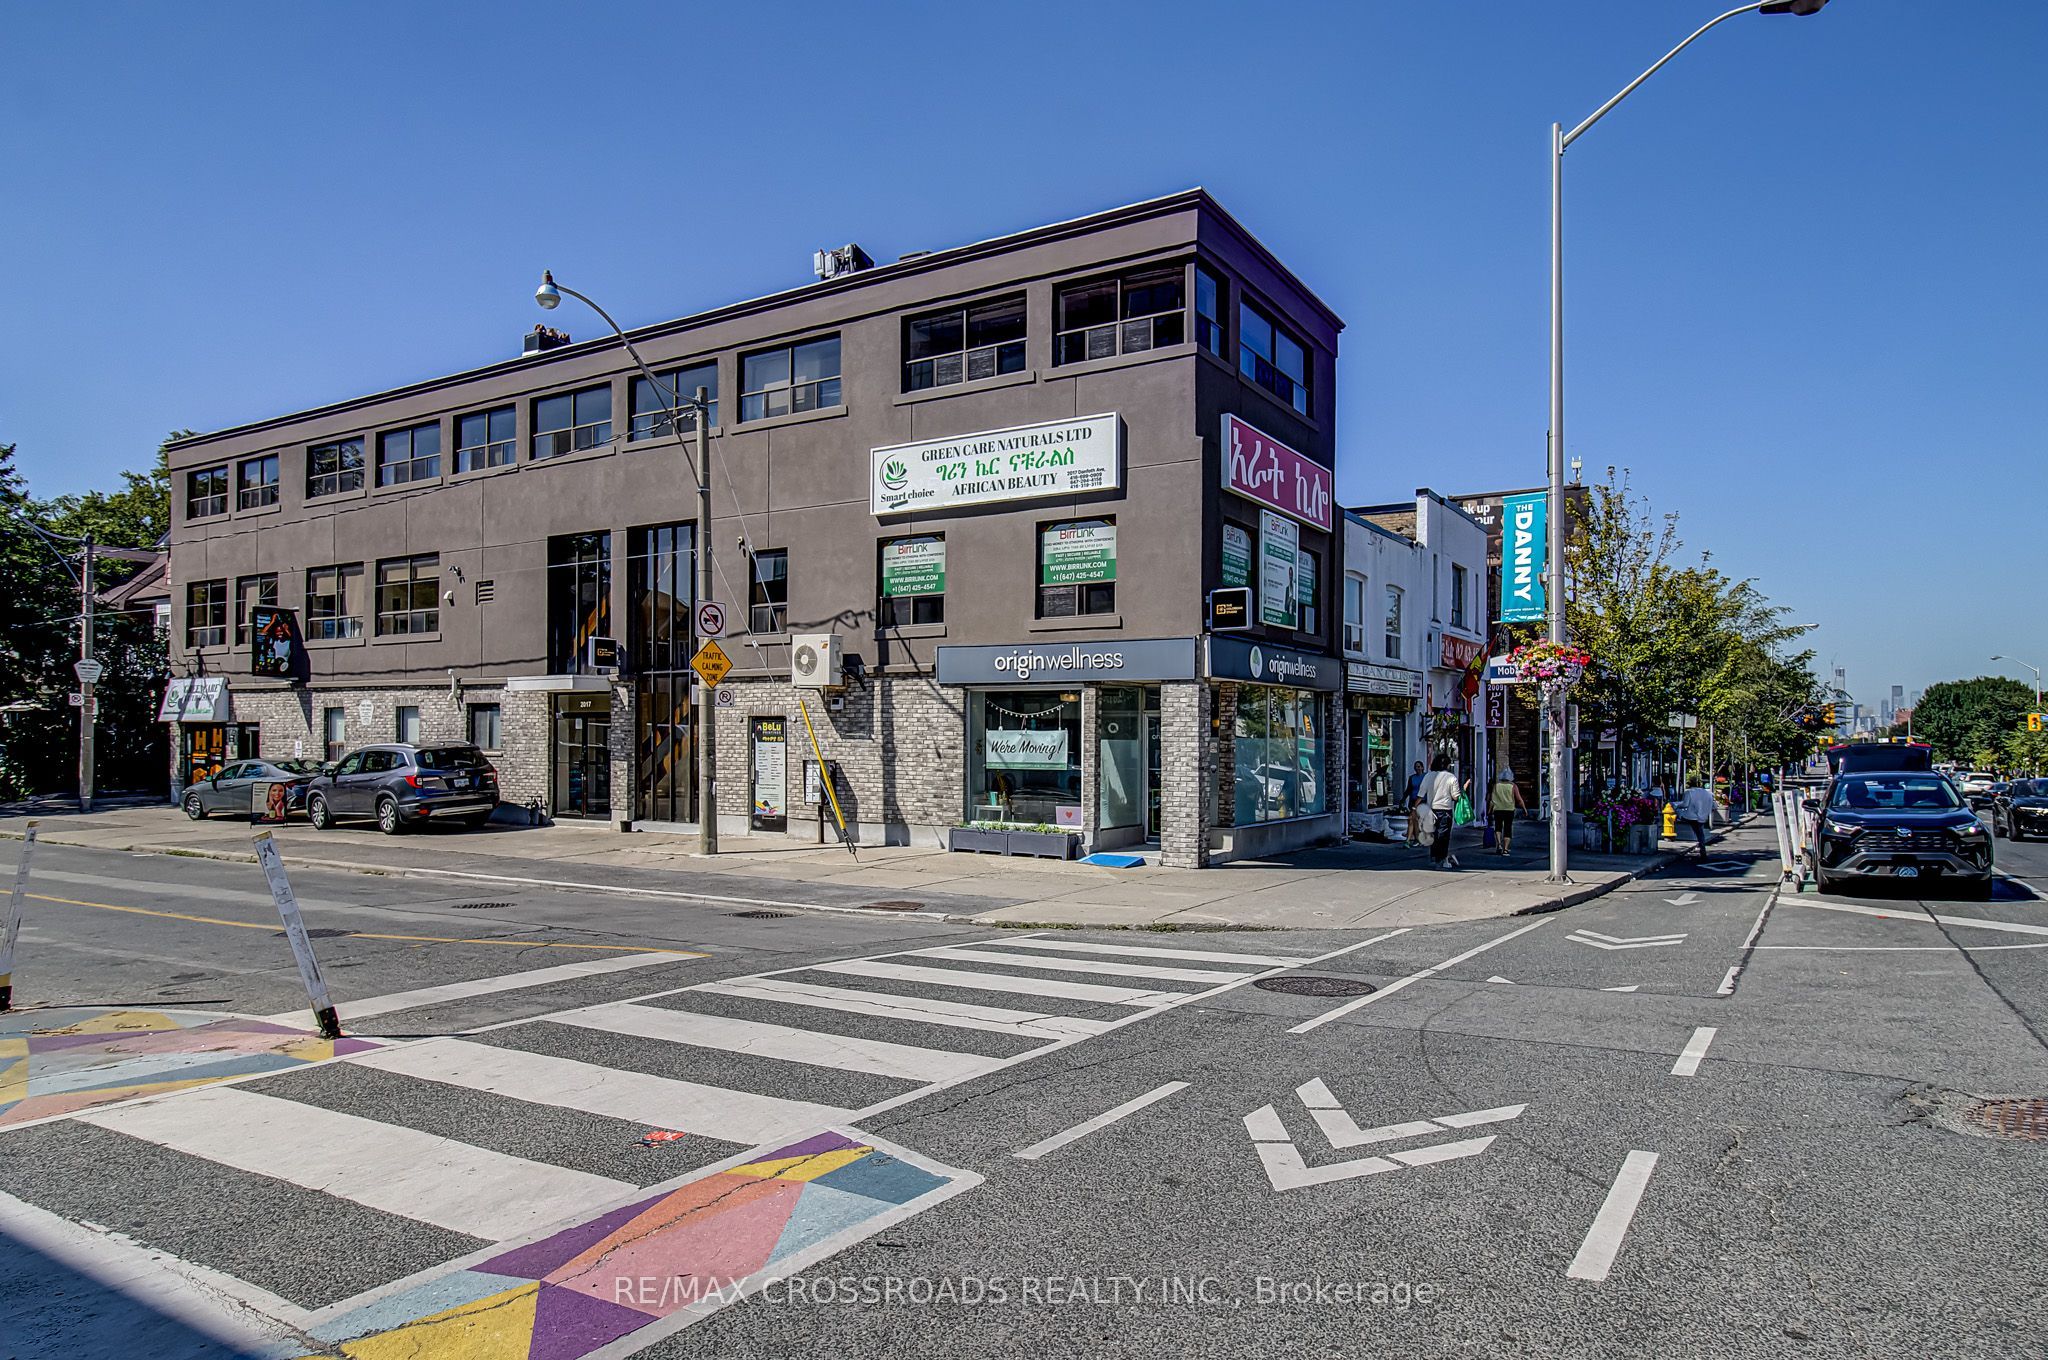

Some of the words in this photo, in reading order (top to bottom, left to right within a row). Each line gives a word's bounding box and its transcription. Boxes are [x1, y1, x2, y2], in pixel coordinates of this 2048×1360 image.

[921, 445, 961, 462] GREEN
[962, 440, 996, 458] CARE
[997, 431, 1064, 453] NATURALS
[1066, 427, 1092, 442] LTD
[952, 479, 1009, 497] AFRICAN
[1008, 472, 1058, 491] BEAUTY
[880, 492, 906, 503] Smart
[908, 487, 935, 500] choice
[1477, 504, 1490, 517] up
[1515, 503, 1534, 512] THE
[1513, 511, 1534, 601] DANNY
[702, 651, 722, 661] TRAFFIC
[702, 662, 723, 671] CALMING
[706, 673, 719, 681] ZONE
[580, 700, 592, 708] 2017
[762, 722, 782, 731] BeLu
[990, 739, 1016, 754] We're
[1020, 740, 1064, 761] Moving!
